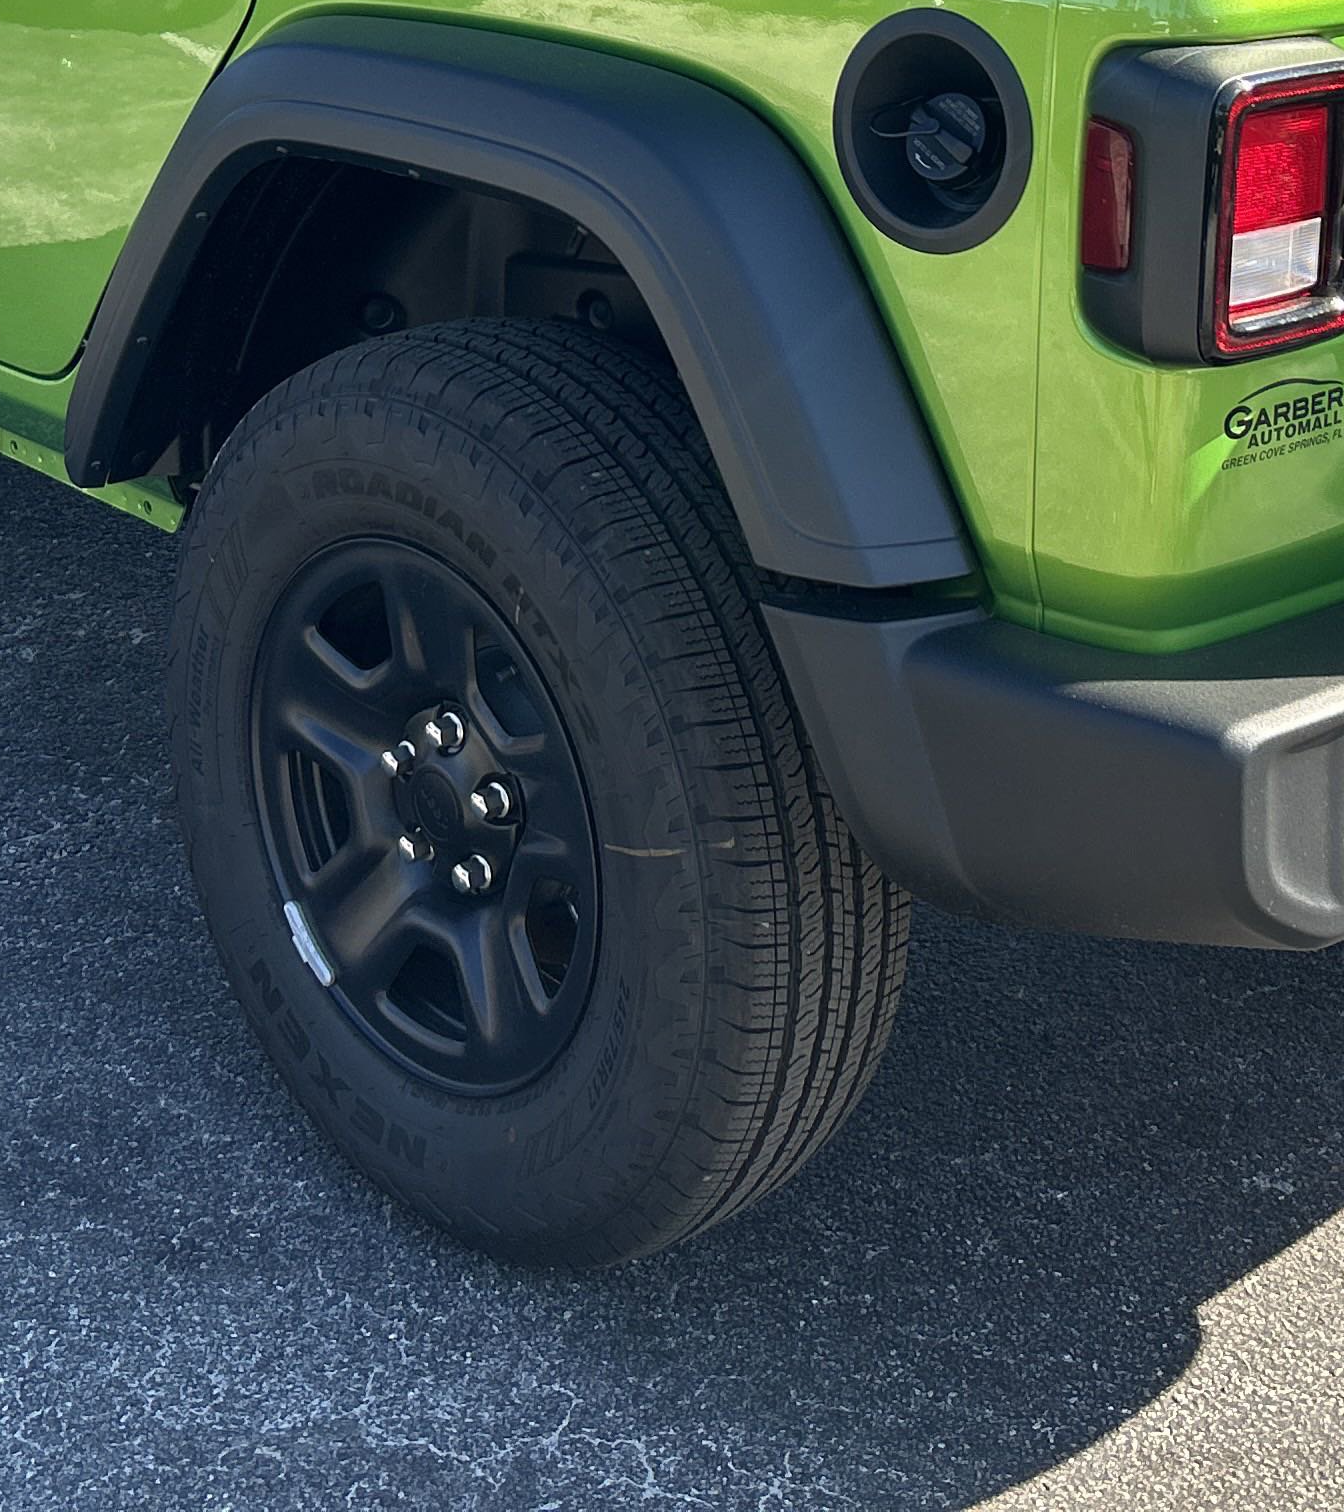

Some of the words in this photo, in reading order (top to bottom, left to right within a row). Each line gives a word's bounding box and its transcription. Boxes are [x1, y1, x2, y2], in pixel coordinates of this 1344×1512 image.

[1224, 386, 1344, 440] GARBER
[1247, 409, 1342, 449] AUTOMALL
[1221, 452, 1258, 470] GREEN
[1259, 445, 1286, 461] COVE
[1287, 432, 1330, 454] SPRINGS,
[1331, 428, 1343, 440] FL
[310, 467, 499, 569] ROADIAN
[251, 958, 427, 1170] NEXEN
